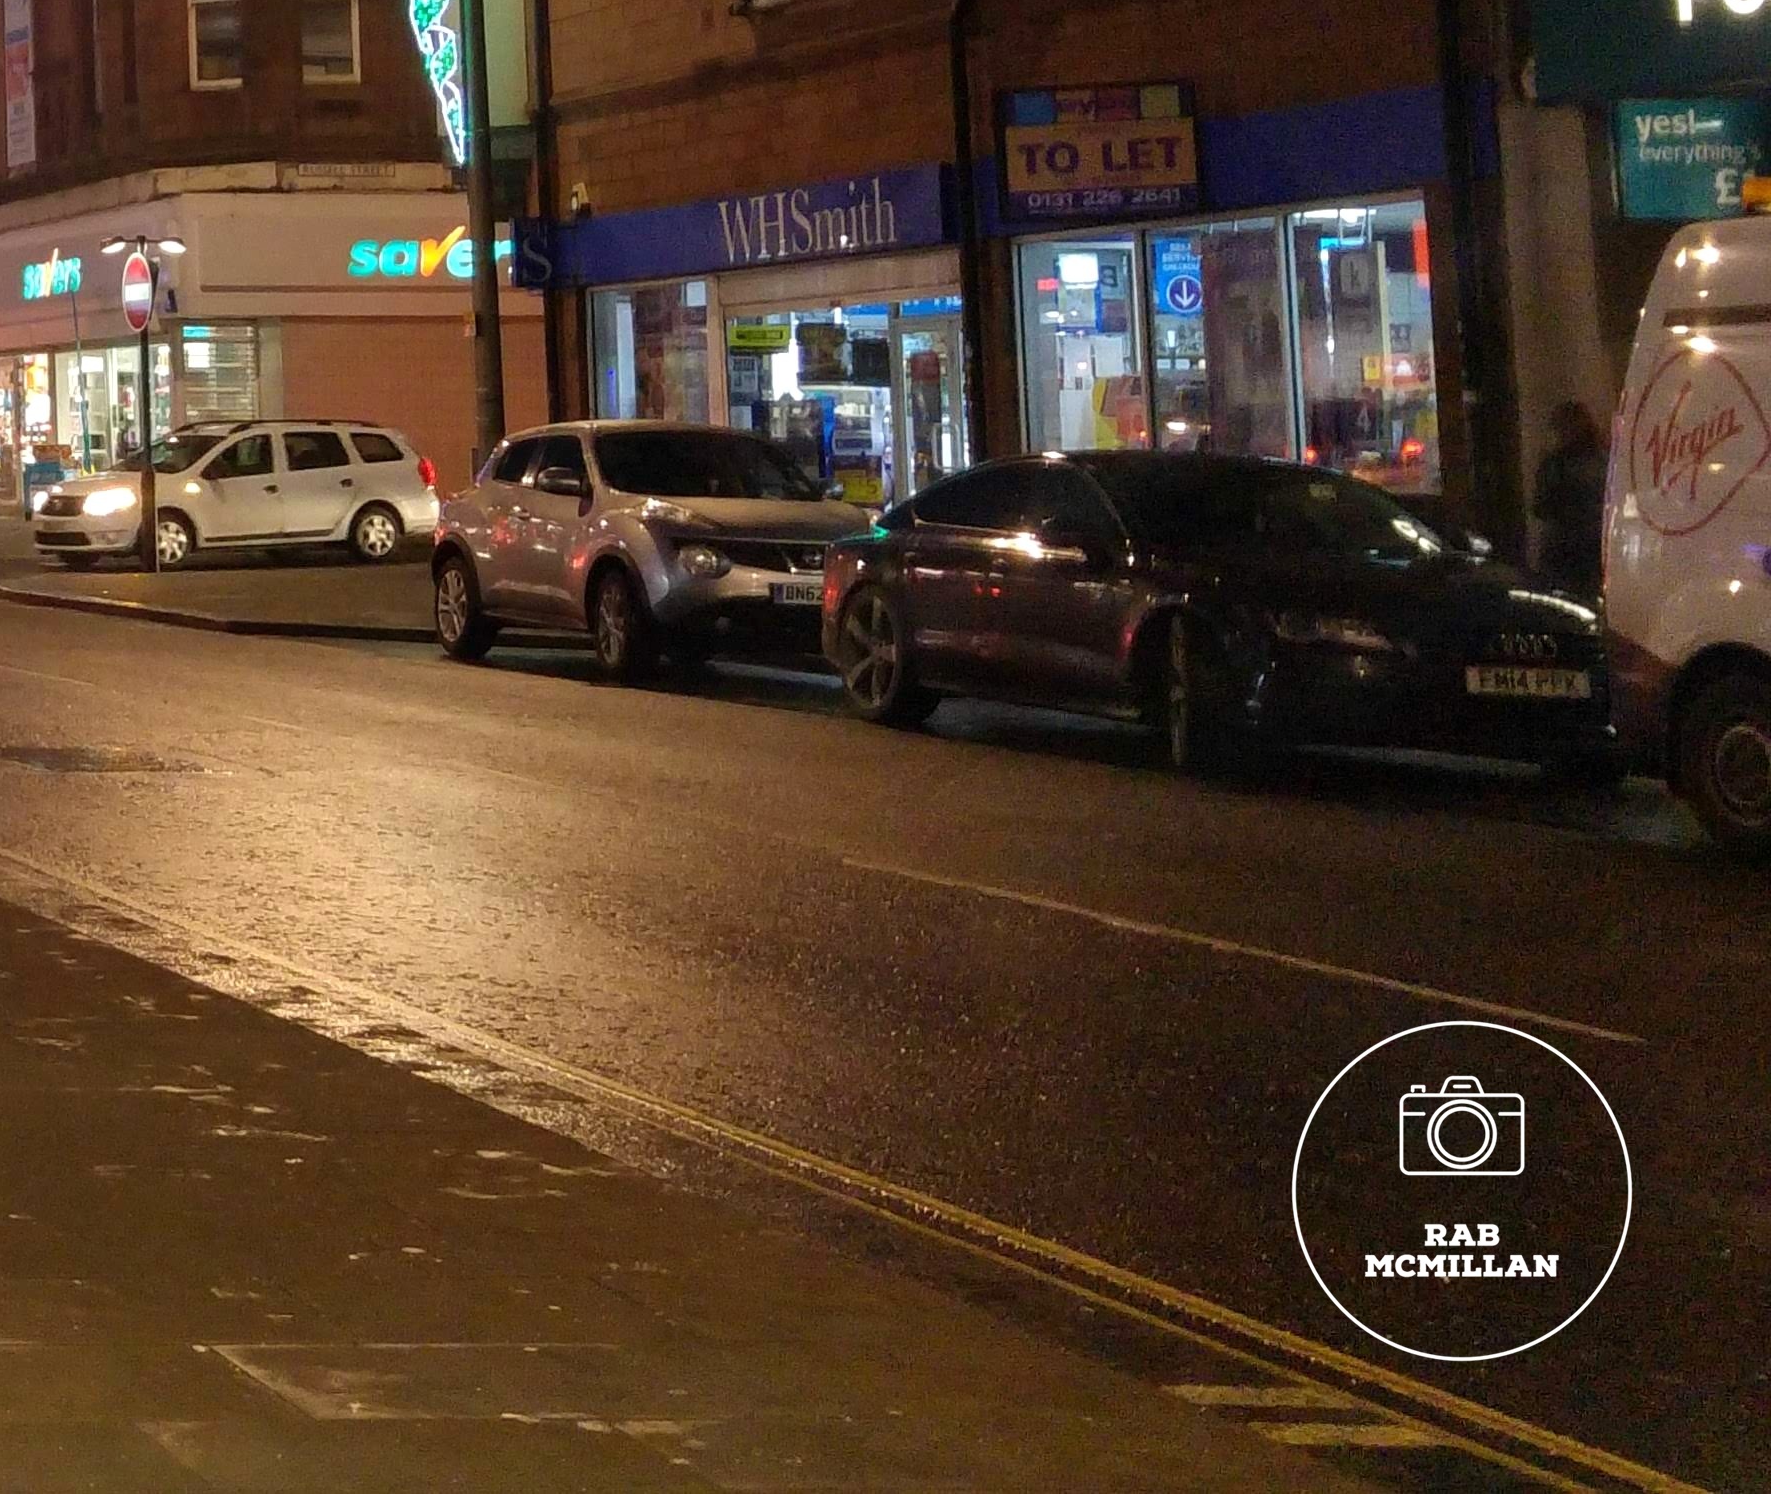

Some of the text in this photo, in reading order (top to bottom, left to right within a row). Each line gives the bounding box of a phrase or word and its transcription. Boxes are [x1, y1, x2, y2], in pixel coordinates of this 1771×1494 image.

[1018, 136, 1187, 177] TO LET
[717, 177, 898, 264] WHSmith
[22, 247, 81, 301] savers
[1644, 380, 1745, 501] Virgin
